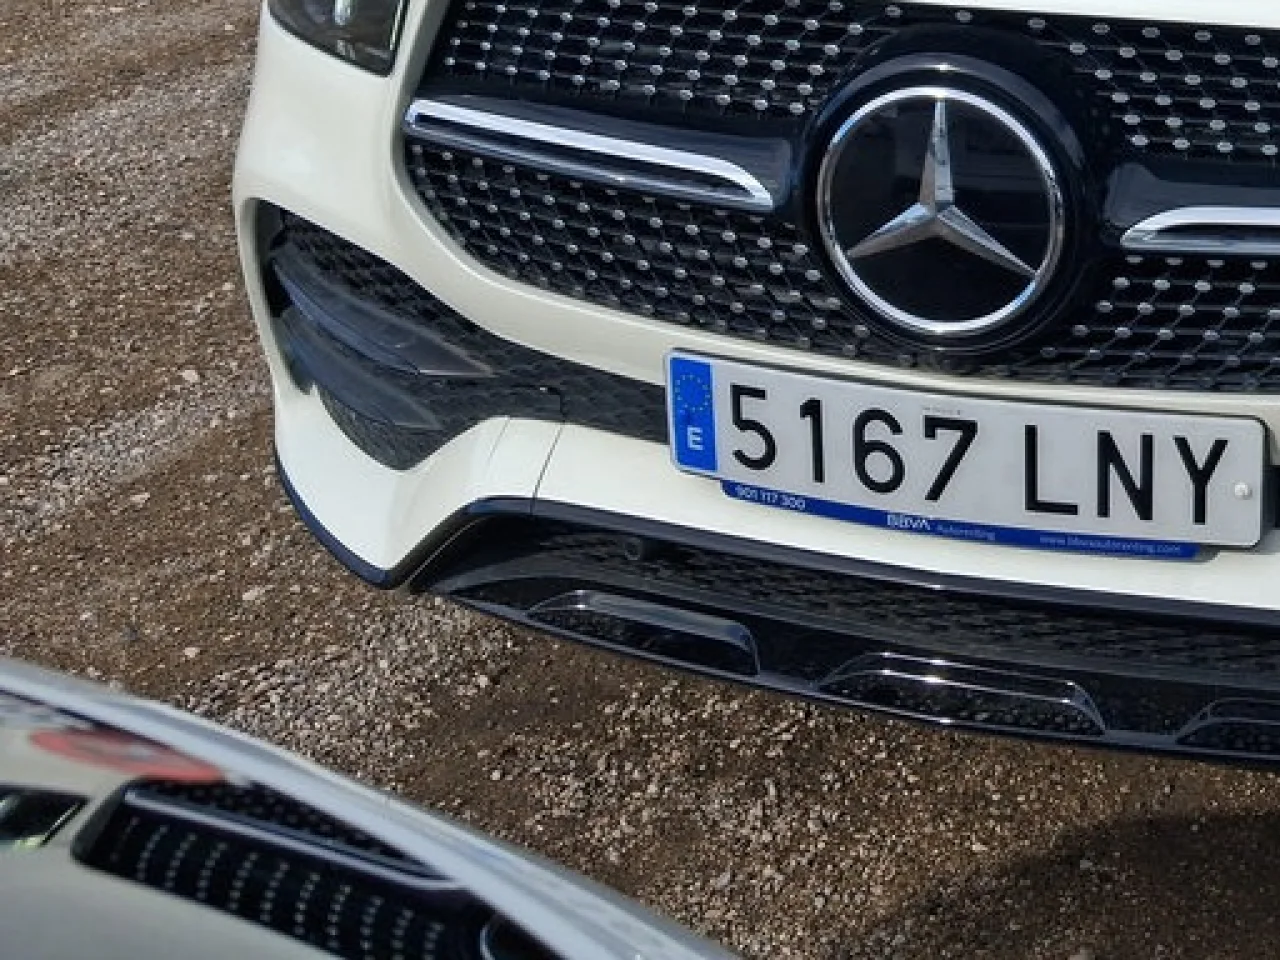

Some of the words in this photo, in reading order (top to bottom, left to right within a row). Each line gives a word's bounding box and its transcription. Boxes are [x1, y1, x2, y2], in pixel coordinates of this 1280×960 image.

[687, 427, 704, 451] E
[730, 383, 978, 502] 5167
[1024, 424, 1229, 525] LNY
[886, 513, 931, 531] BBVA
